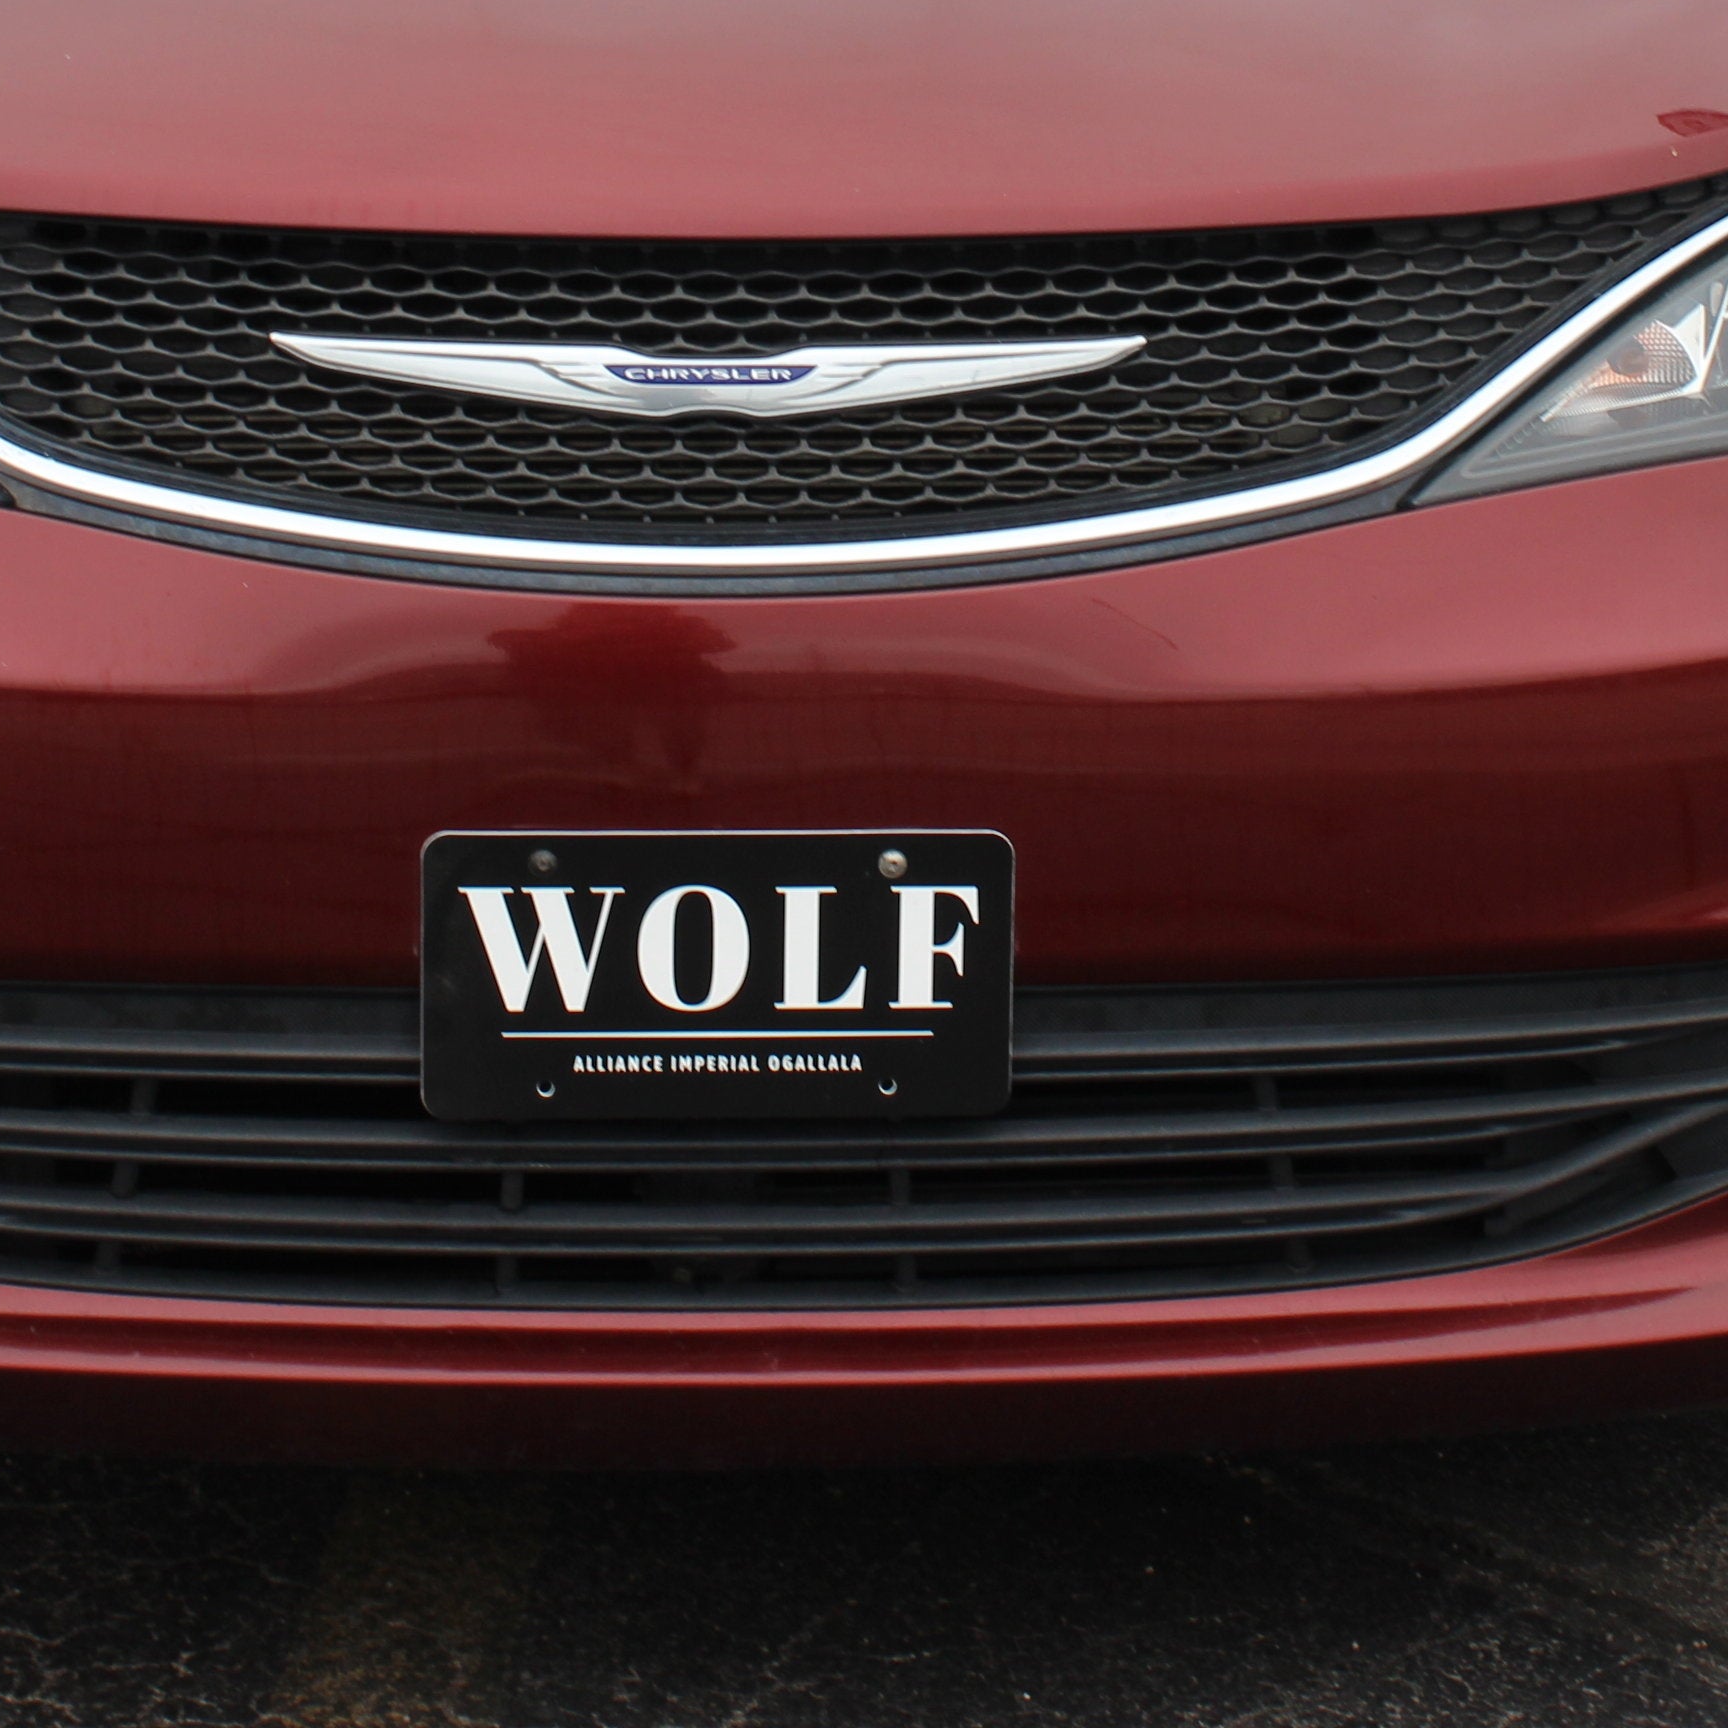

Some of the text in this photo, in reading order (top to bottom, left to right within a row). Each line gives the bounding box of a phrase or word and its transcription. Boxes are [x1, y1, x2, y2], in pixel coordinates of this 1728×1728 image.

[624, 366, 792, 381] CHRYSLER
[457, 884, 980, 1013] WOLF
[573, 1053, 863, 1073] ALLIANCE IMPERIAL OGALLALA
